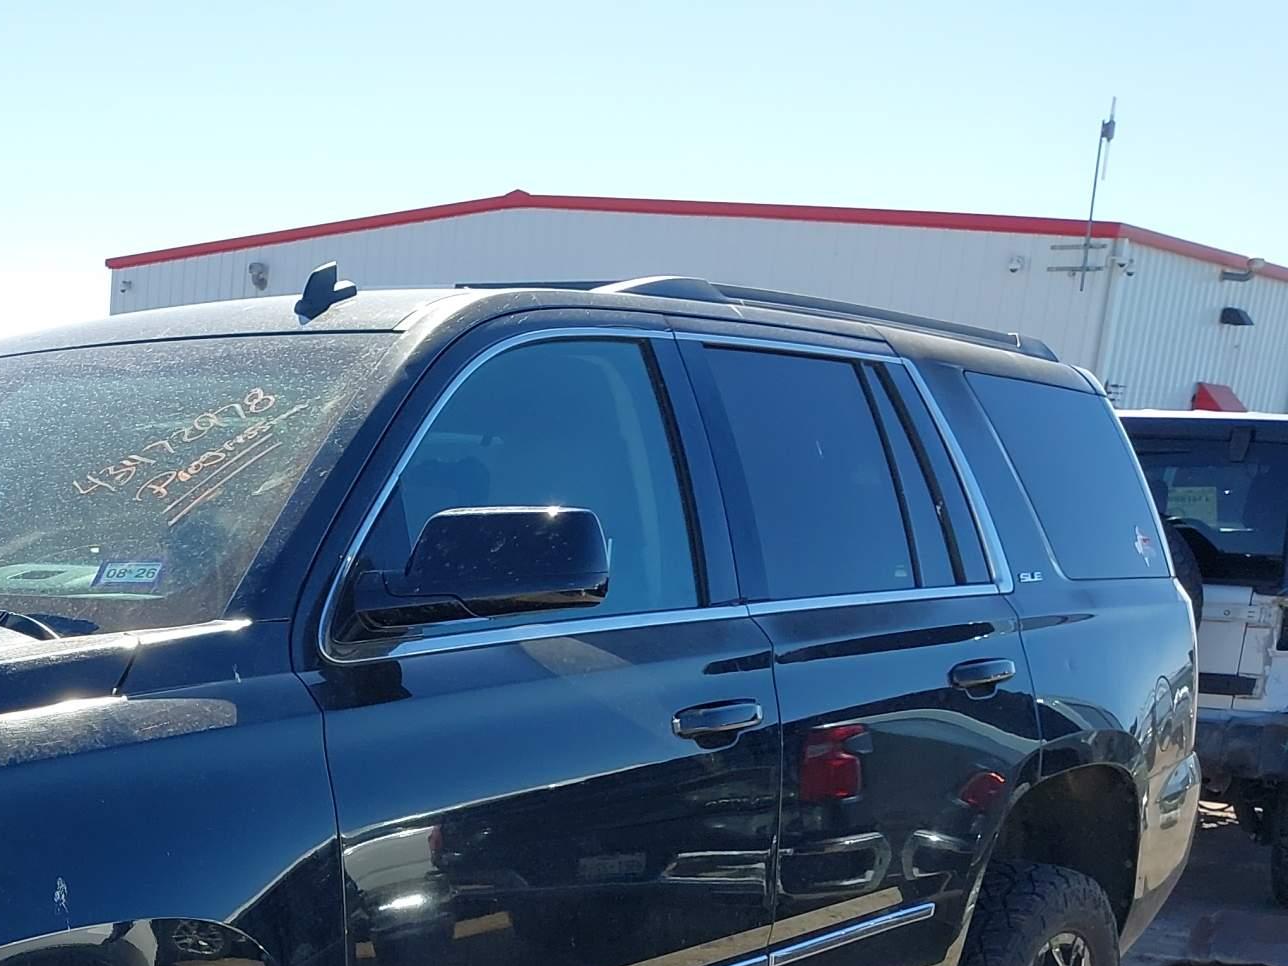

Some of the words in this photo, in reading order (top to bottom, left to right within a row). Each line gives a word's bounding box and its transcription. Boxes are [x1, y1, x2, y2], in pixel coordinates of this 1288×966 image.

[105, 566, 127, 580] 08
[135, 566, 156, 580] 26
[1018, 571, 1044, 583] SLE
